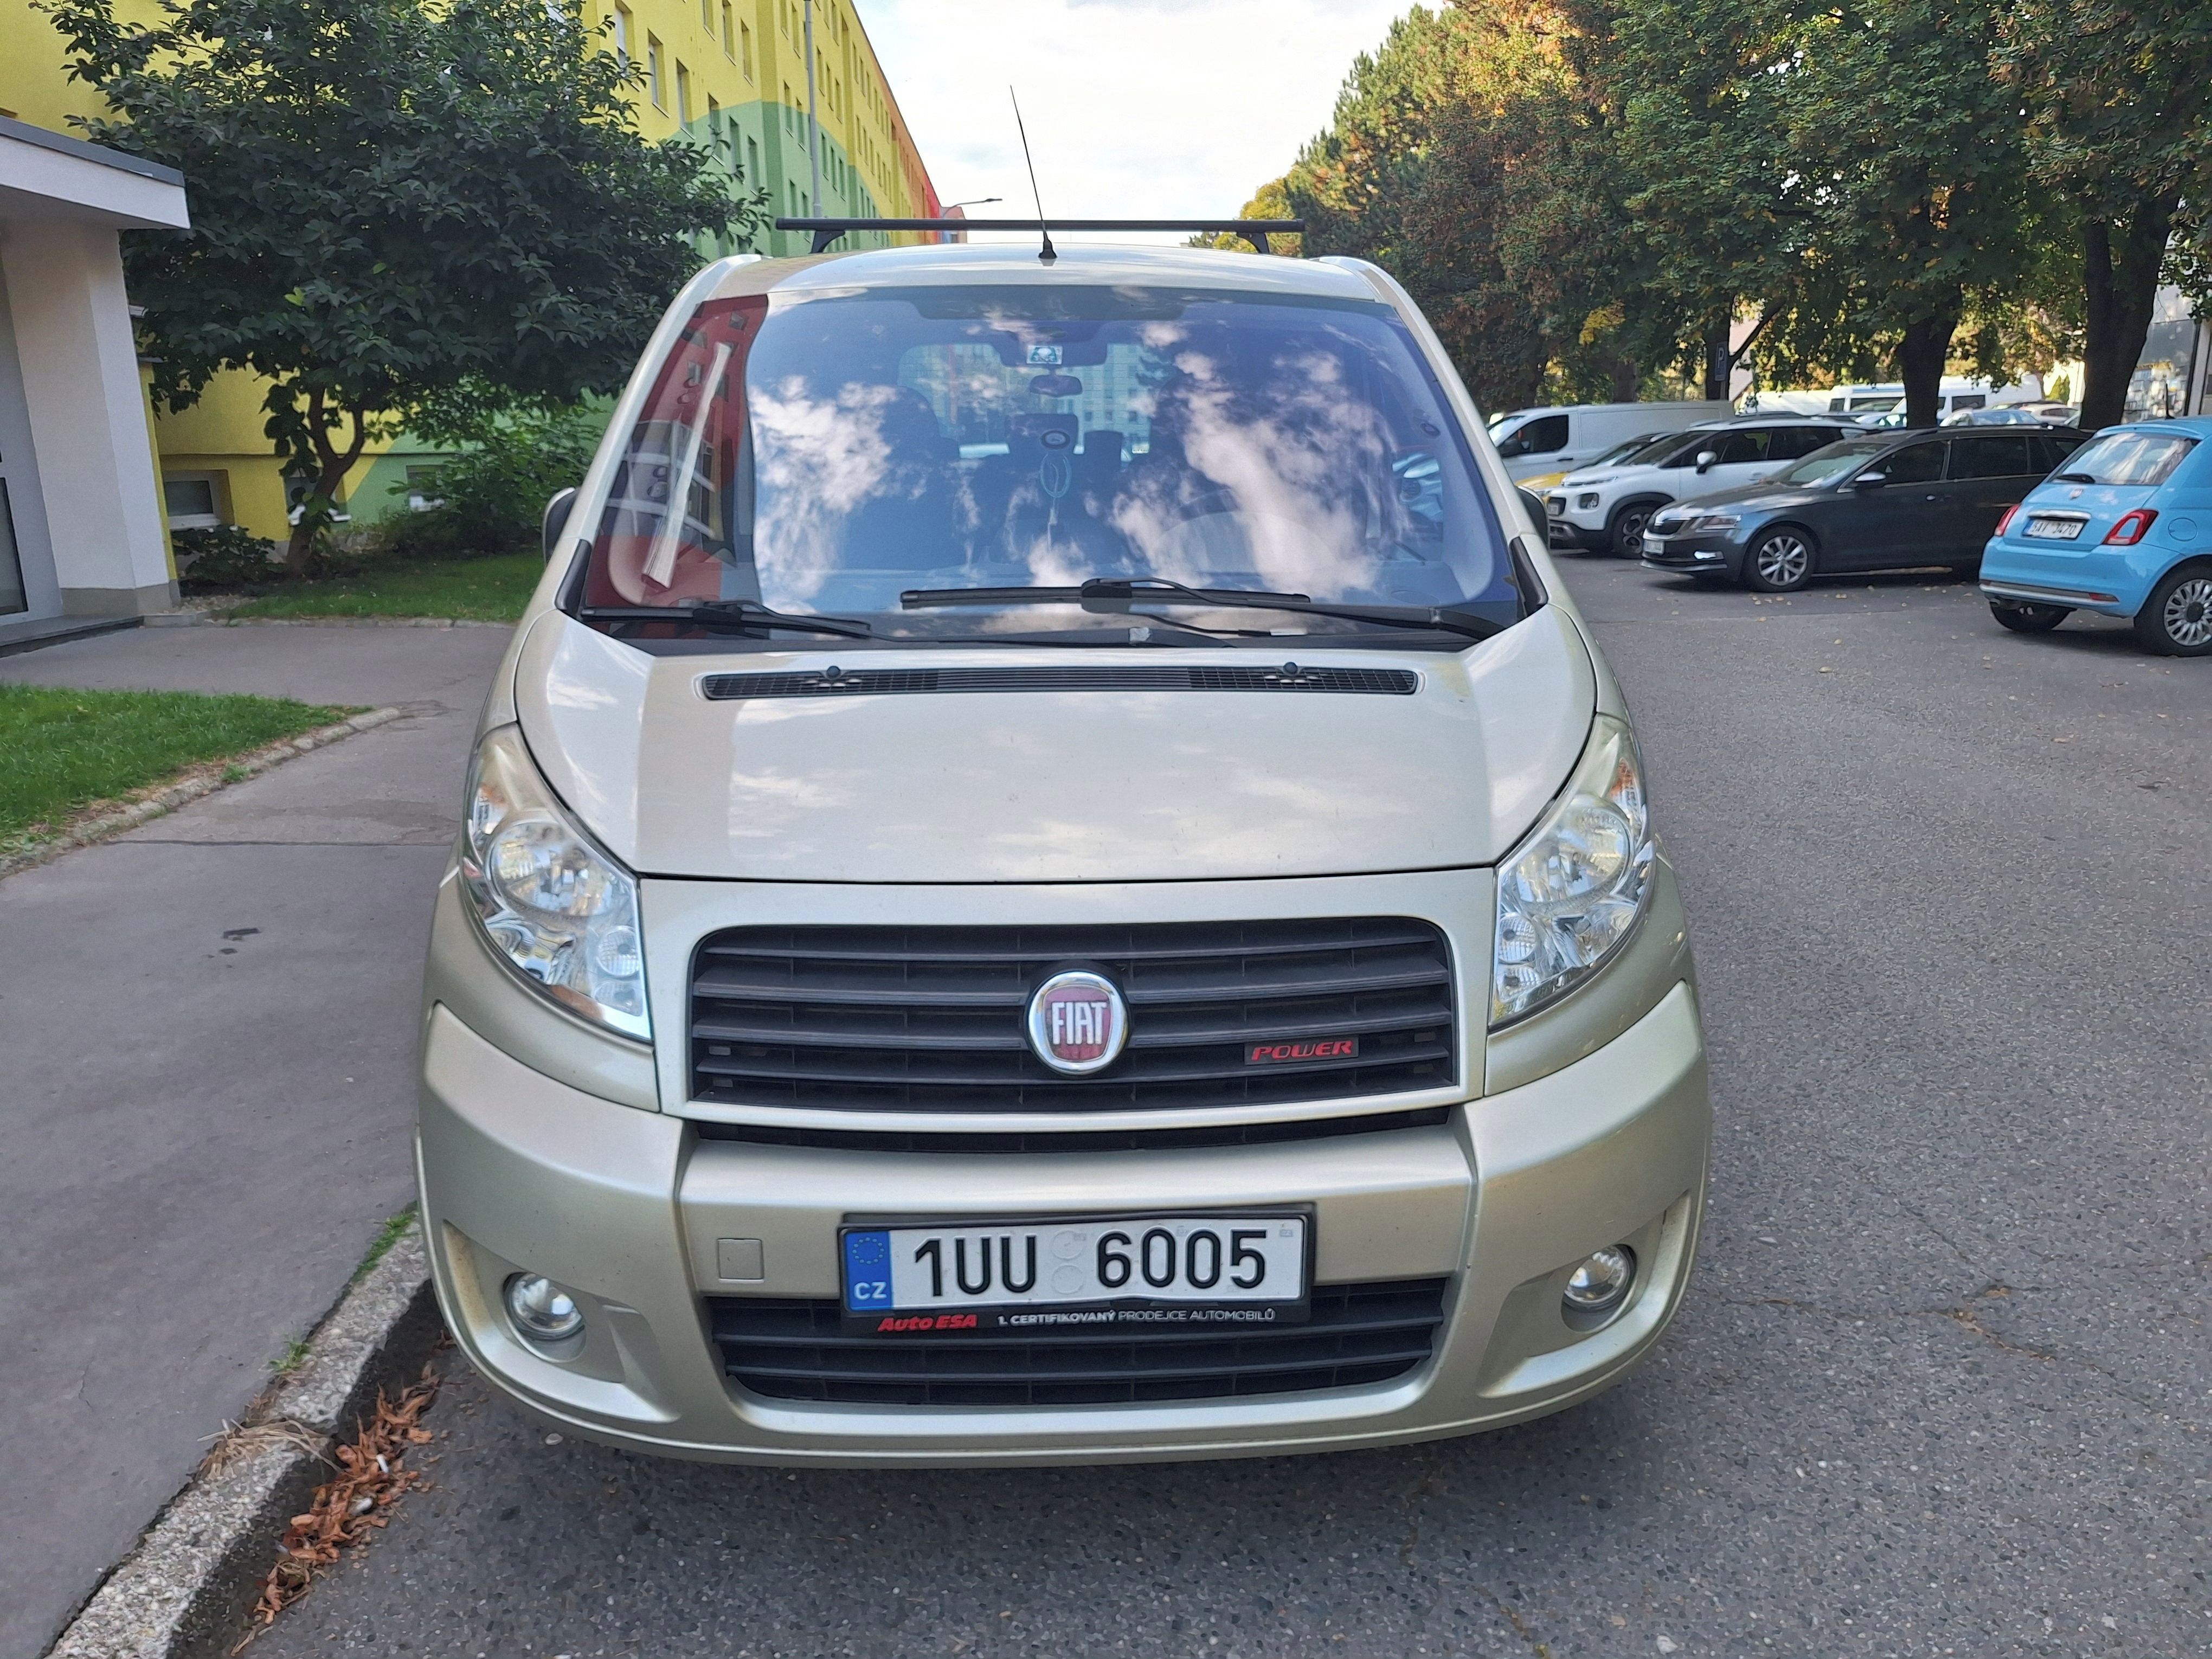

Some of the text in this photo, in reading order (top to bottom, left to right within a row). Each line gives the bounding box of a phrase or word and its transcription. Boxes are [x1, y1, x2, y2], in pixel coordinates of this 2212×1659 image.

[1051, 1001, 1107, 1045] FIAT
[1251, 1040, 1354, 1061] POWER
[915, 1227, 1267, 1297] 1UU 6005
[854, 1282, 886, 1300] CZ
[877, 1314, 978, 1332] Auto ESA
[1010, 1309, 1115, 1326] CERTIFIKOVANÝ
[1117, 1310, 1187, 1323] PRODEJCE
[1189, 1308, 1275, 1321] AUTOMOBILŮ
